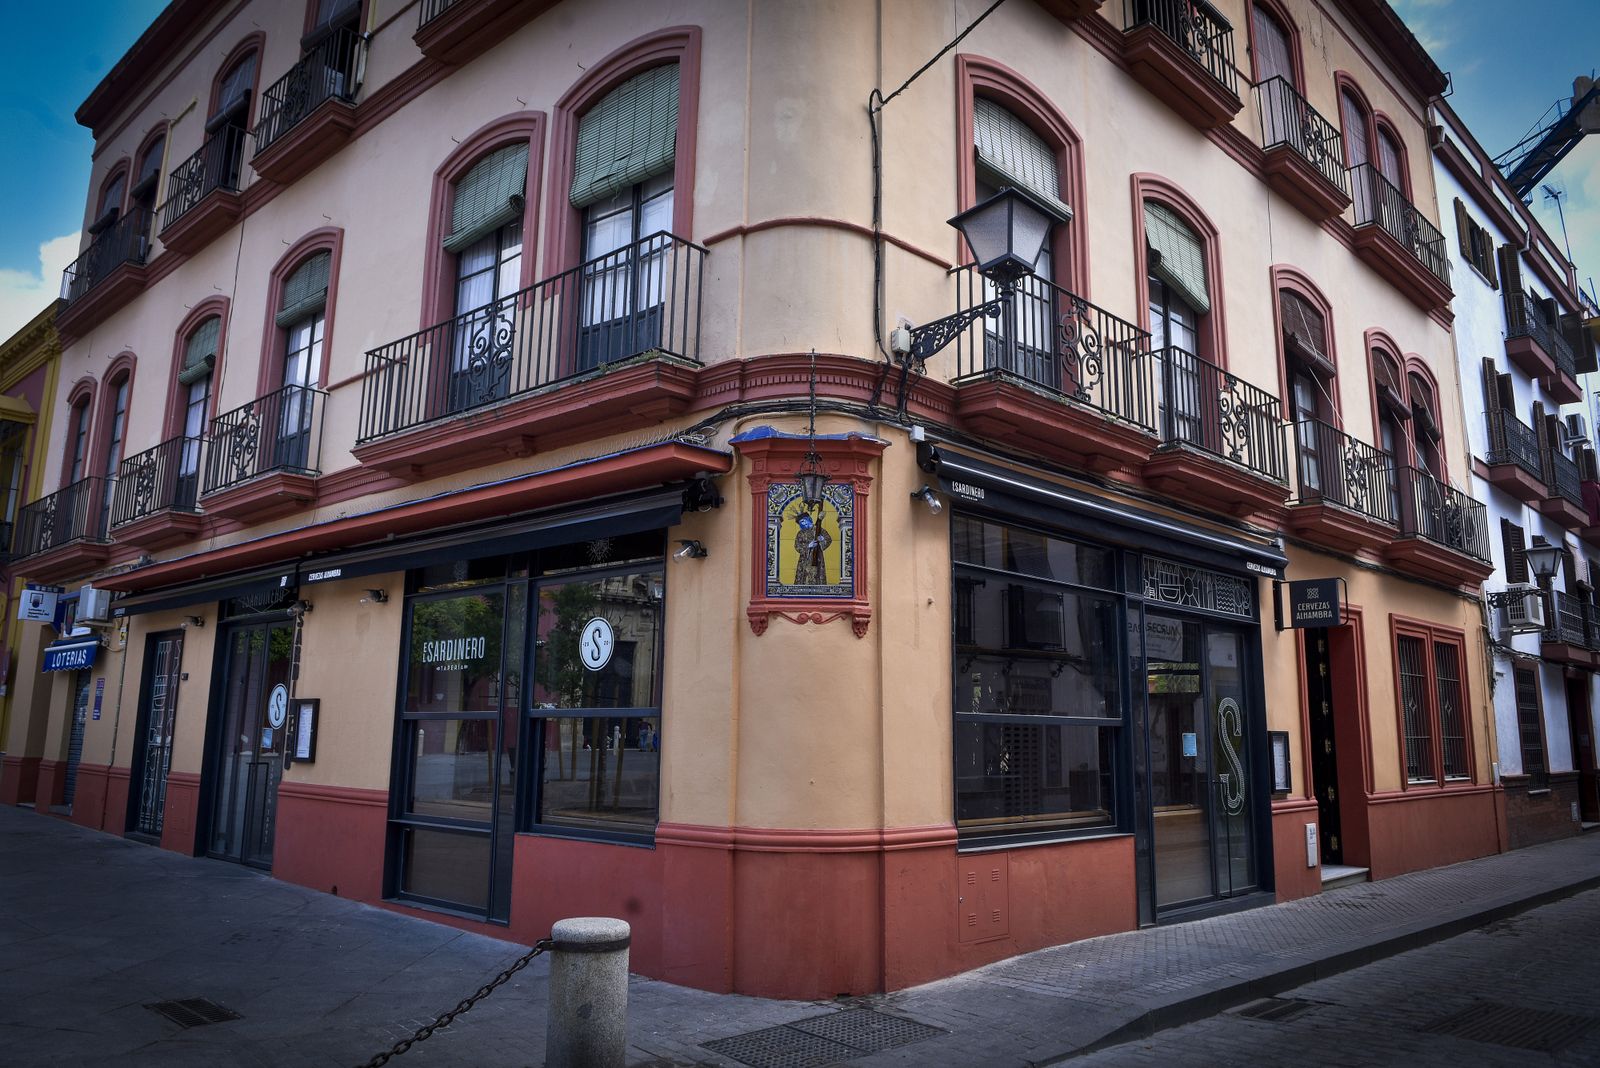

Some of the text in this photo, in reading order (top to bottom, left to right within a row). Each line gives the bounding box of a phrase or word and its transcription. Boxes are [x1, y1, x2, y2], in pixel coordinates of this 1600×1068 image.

[1297, 601, 1330, 611] CERVEZAS
[1296, 610, 1333, 620] ALHAMBRA
[427, 636, 485, 662] SARDINERO
[51, 649, 87, 668] LOTERIAS
